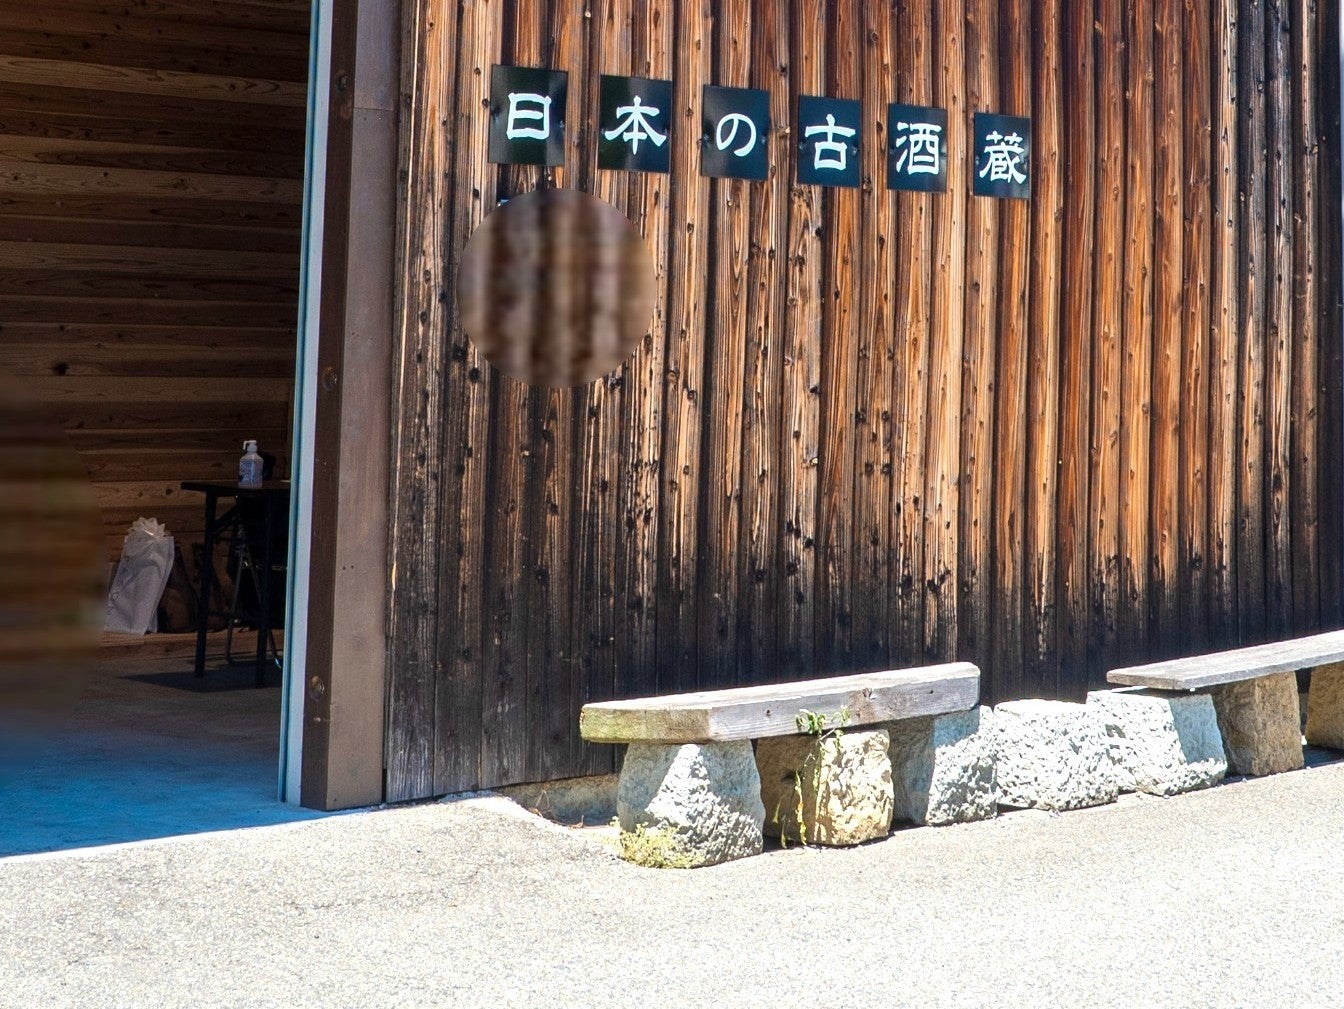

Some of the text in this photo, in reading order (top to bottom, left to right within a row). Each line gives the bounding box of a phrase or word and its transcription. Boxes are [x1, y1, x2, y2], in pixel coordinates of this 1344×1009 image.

[506, 91, 1027, 185] 日本の古酒蔵
